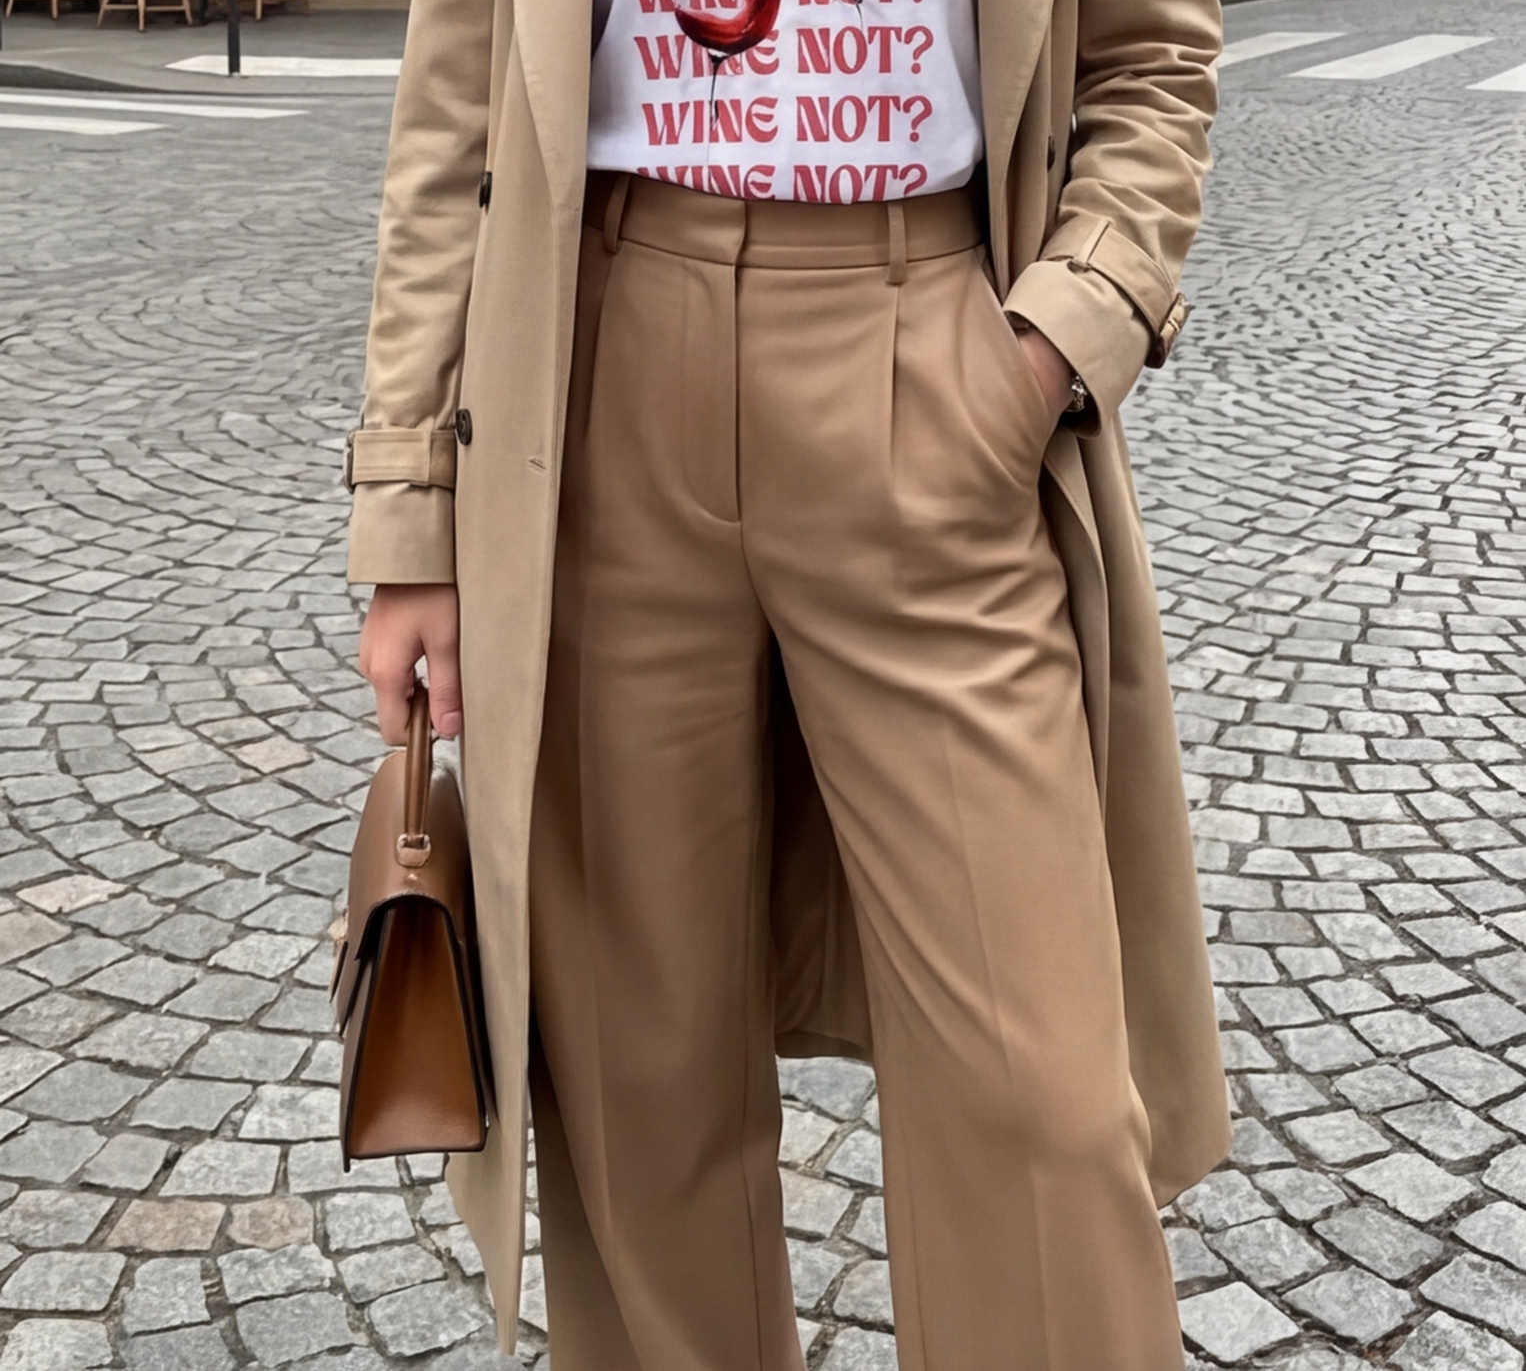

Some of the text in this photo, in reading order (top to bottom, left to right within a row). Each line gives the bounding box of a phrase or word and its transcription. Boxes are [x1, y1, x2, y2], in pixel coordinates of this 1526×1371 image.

[797, 25, 934, 75] NOT?
[642, 95, 933, 146] WINE NOT?
[794, 164, 929, 204] NOT?
